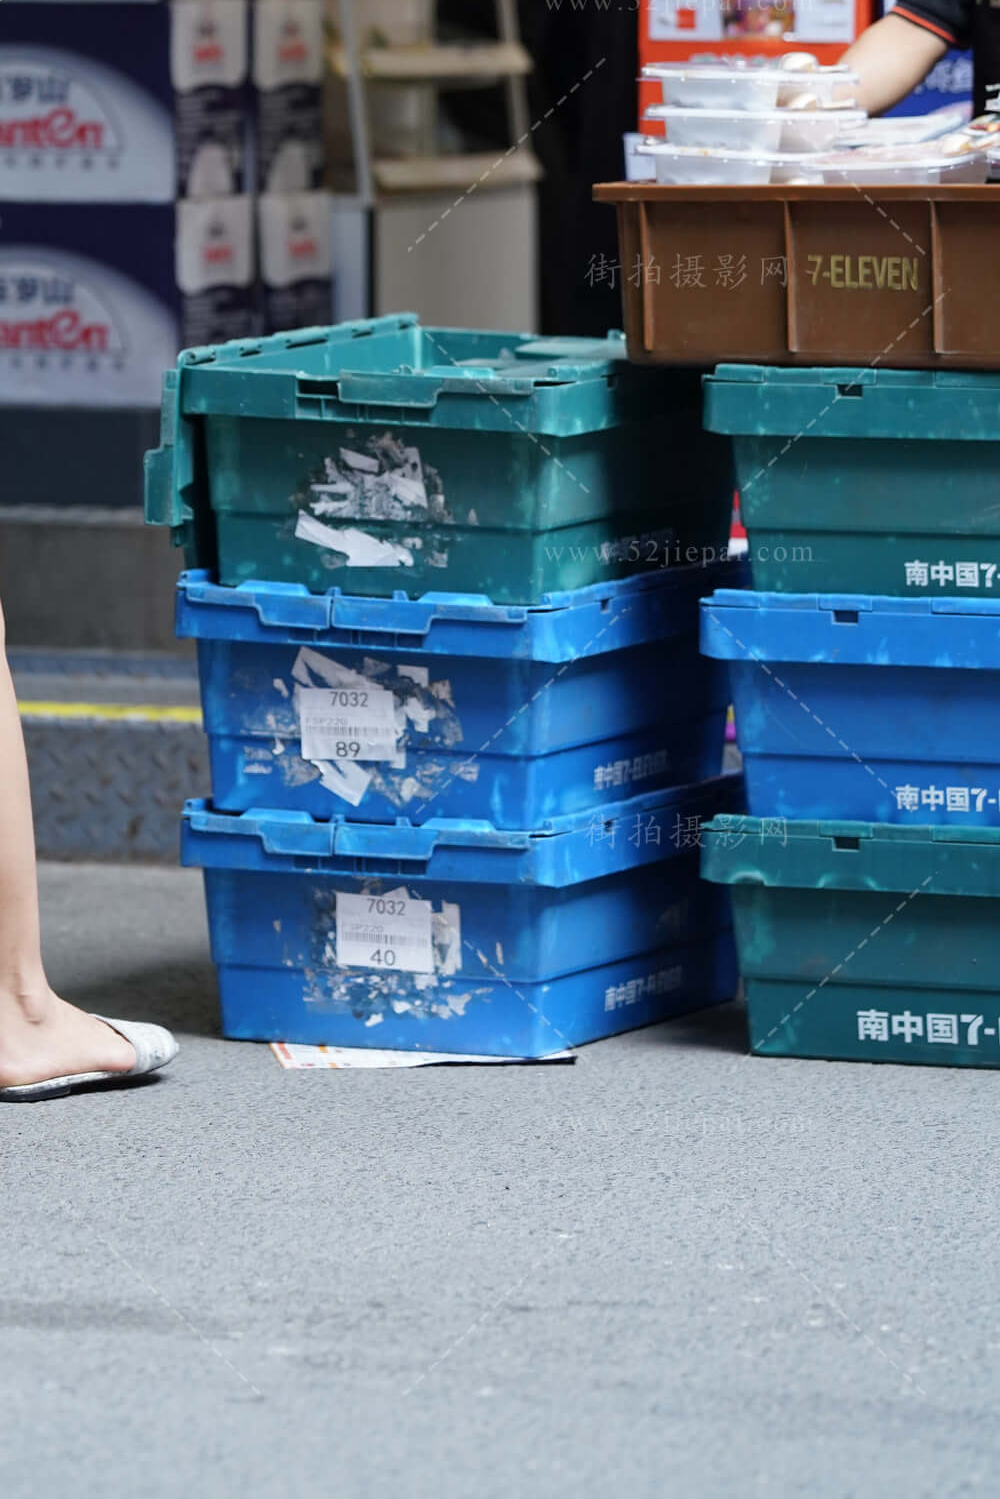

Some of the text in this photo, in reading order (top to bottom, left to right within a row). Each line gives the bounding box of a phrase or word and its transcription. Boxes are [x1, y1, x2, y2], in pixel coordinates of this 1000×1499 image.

[808, 255, 918, 291] 7-ELEVEN
[329, 691, 369, 707] 7032
[335, 741, 361, 758] 89
[895, 784, 1000, 812] 南中国7-
[366, 898, 406, 916] 7032
[370, 949, 396, 966] 40
[857, 1009, 1000, 1045] 南中国7-
